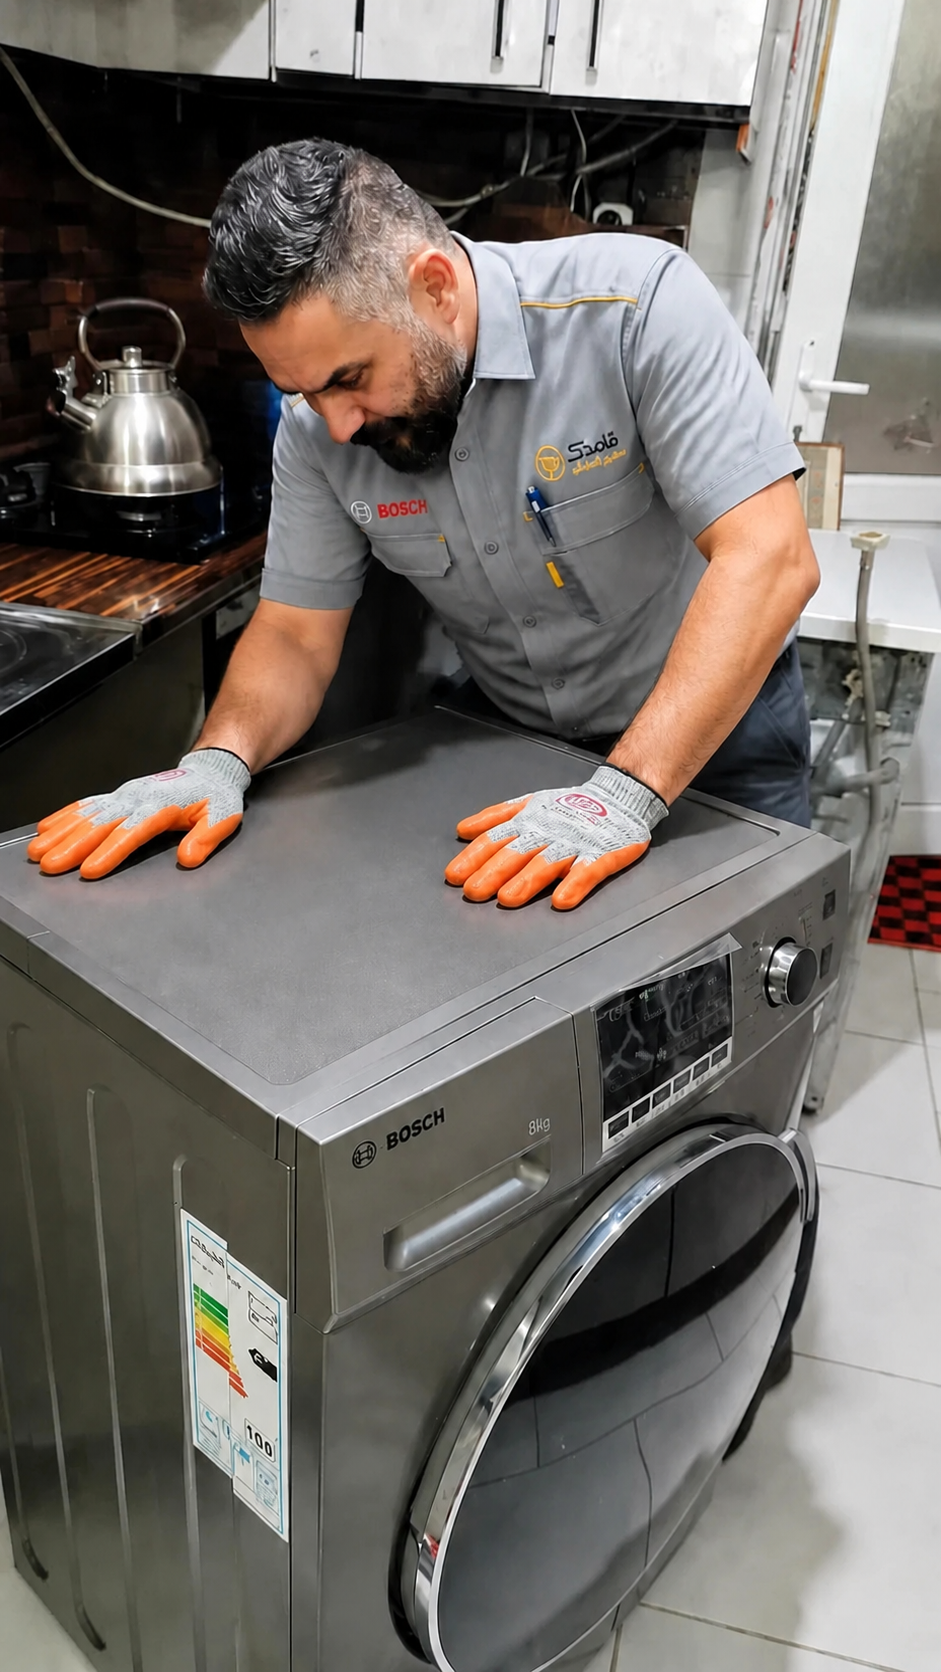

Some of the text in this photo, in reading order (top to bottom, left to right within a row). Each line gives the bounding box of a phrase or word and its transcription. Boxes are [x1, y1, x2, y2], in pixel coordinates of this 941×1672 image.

[377, 499, 428, 519] BOSCH
[386, 1107, 446, 1150] BOSCH
[246, 1424, 273, 1458] 100
